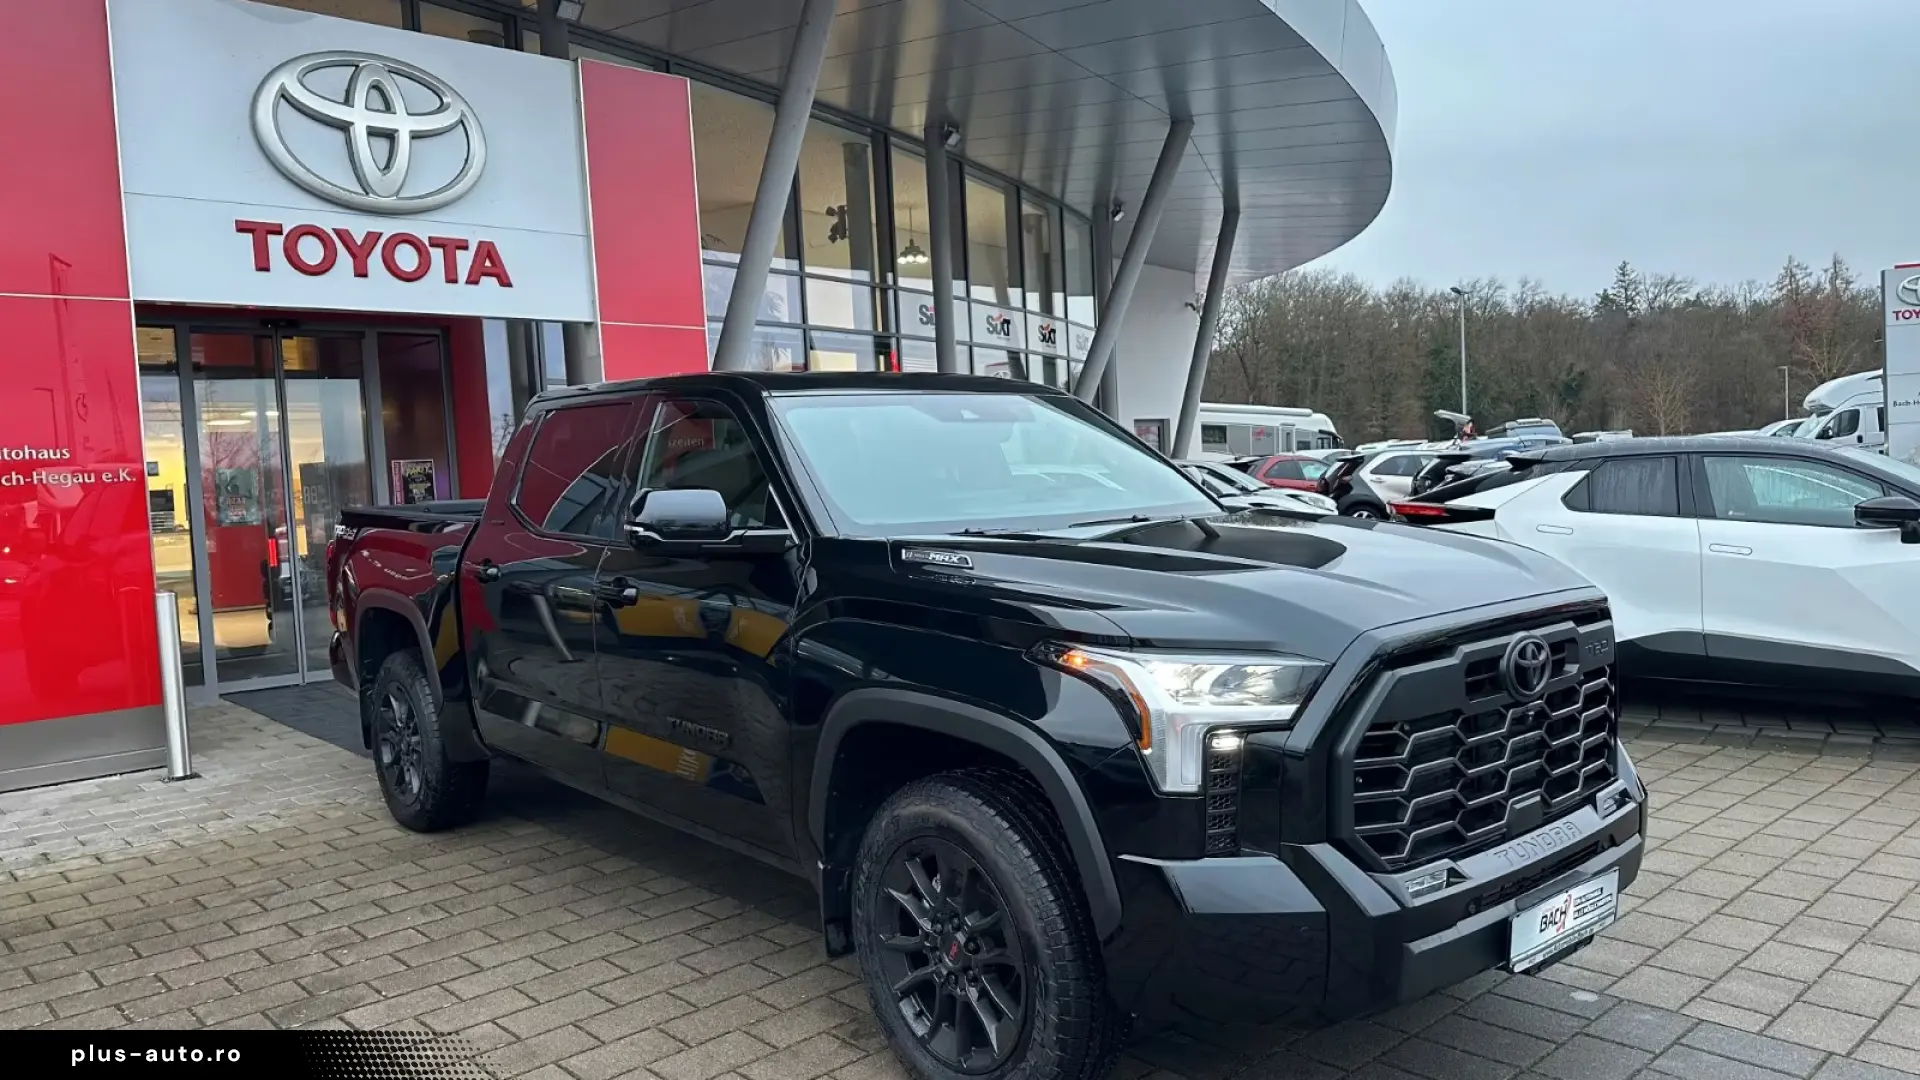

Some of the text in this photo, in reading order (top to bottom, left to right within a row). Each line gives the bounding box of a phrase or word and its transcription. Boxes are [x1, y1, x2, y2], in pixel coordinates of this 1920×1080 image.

[235, 219, 513, 288] TOYOTA
[0, 444, 71, 460] tohaus
[0, 467, 137, 488] ch-Hegau e.K.
[1493, 820, 1583, 867] TUNDRA
[1539, 902, 1568, 934] BACH
